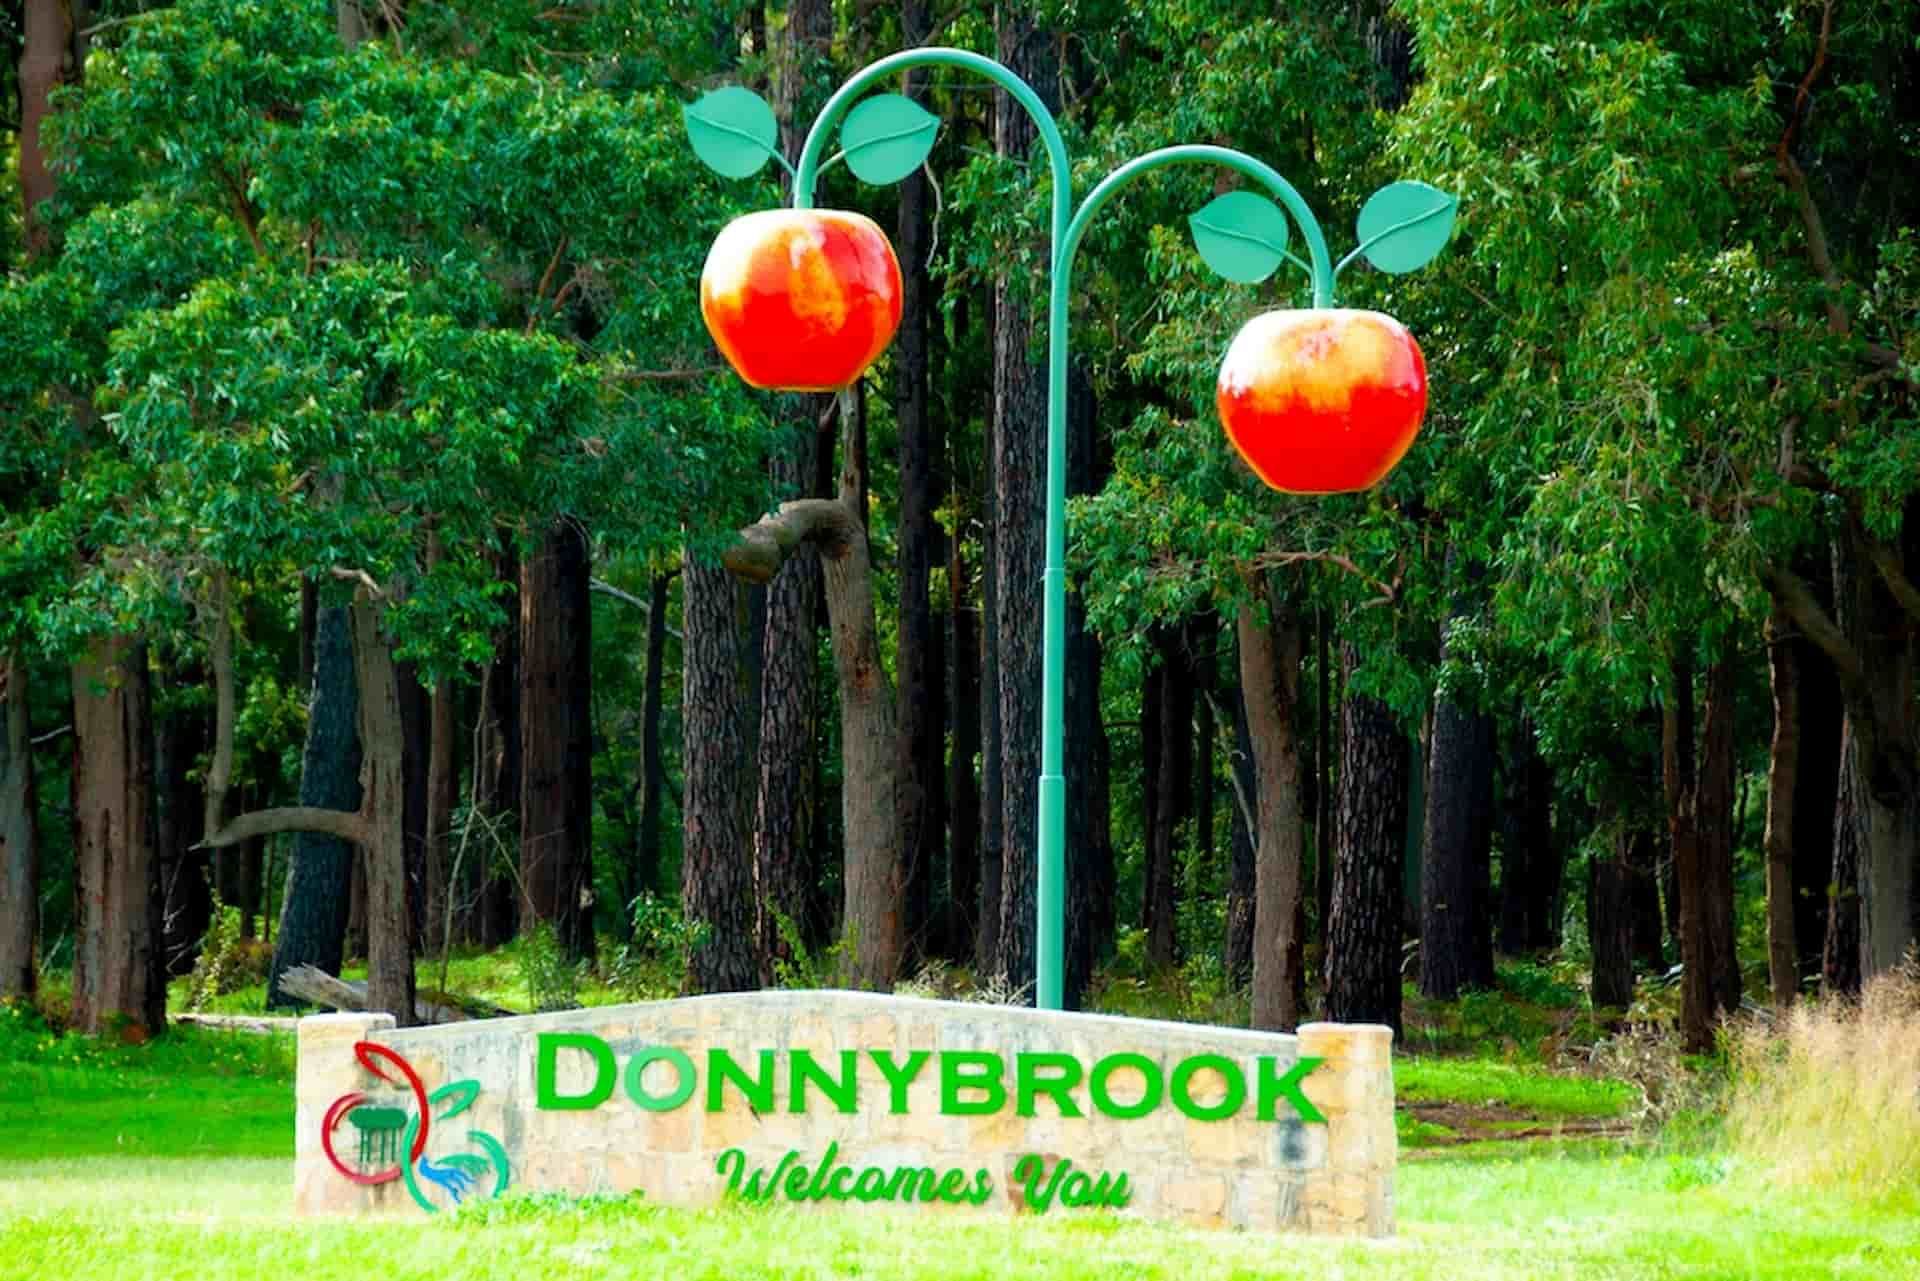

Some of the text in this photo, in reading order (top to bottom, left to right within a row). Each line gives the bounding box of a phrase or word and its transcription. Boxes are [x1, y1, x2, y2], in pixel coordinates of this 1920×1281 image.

[536, 1032, 1328, 1123] DONNYBROOK
[716, 1141, 1133, 1214] Welcomes You
